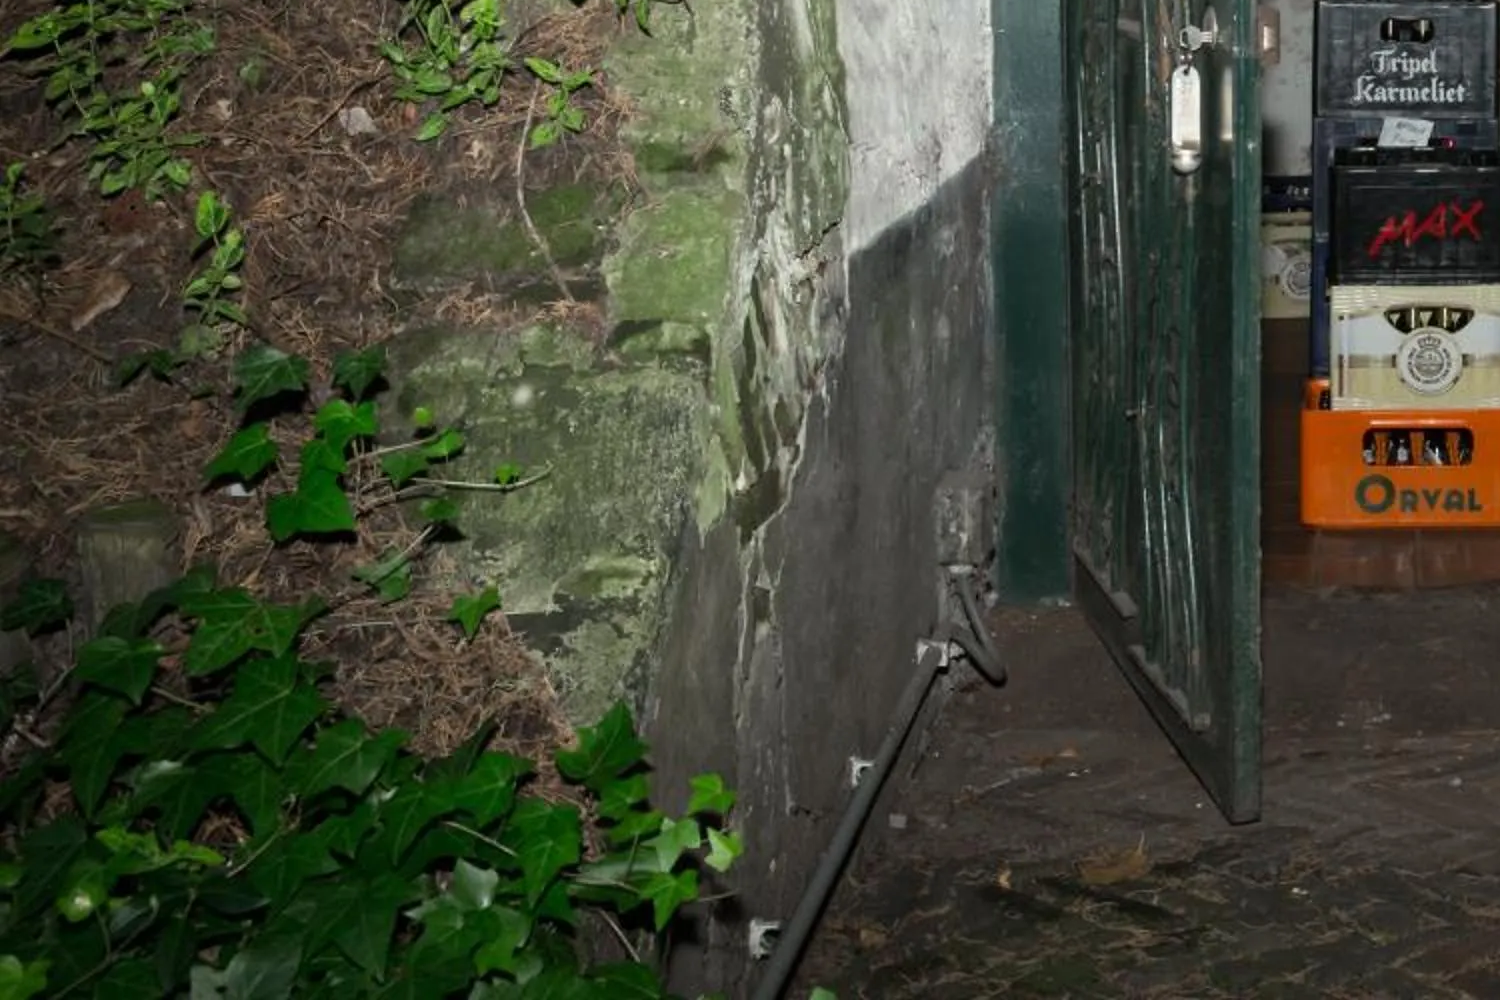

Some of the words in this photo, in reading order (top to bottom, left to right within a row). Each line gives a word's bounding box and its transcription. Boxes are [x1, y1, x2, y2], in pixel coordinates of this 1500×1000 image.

[1369, 45, 1438, 81] Tripel
[1351, 73, 1467, 104] Karmeliet
[1368, 199, 1484, 259] MAX
[1355, 473, 1483, 514] ORVAL
